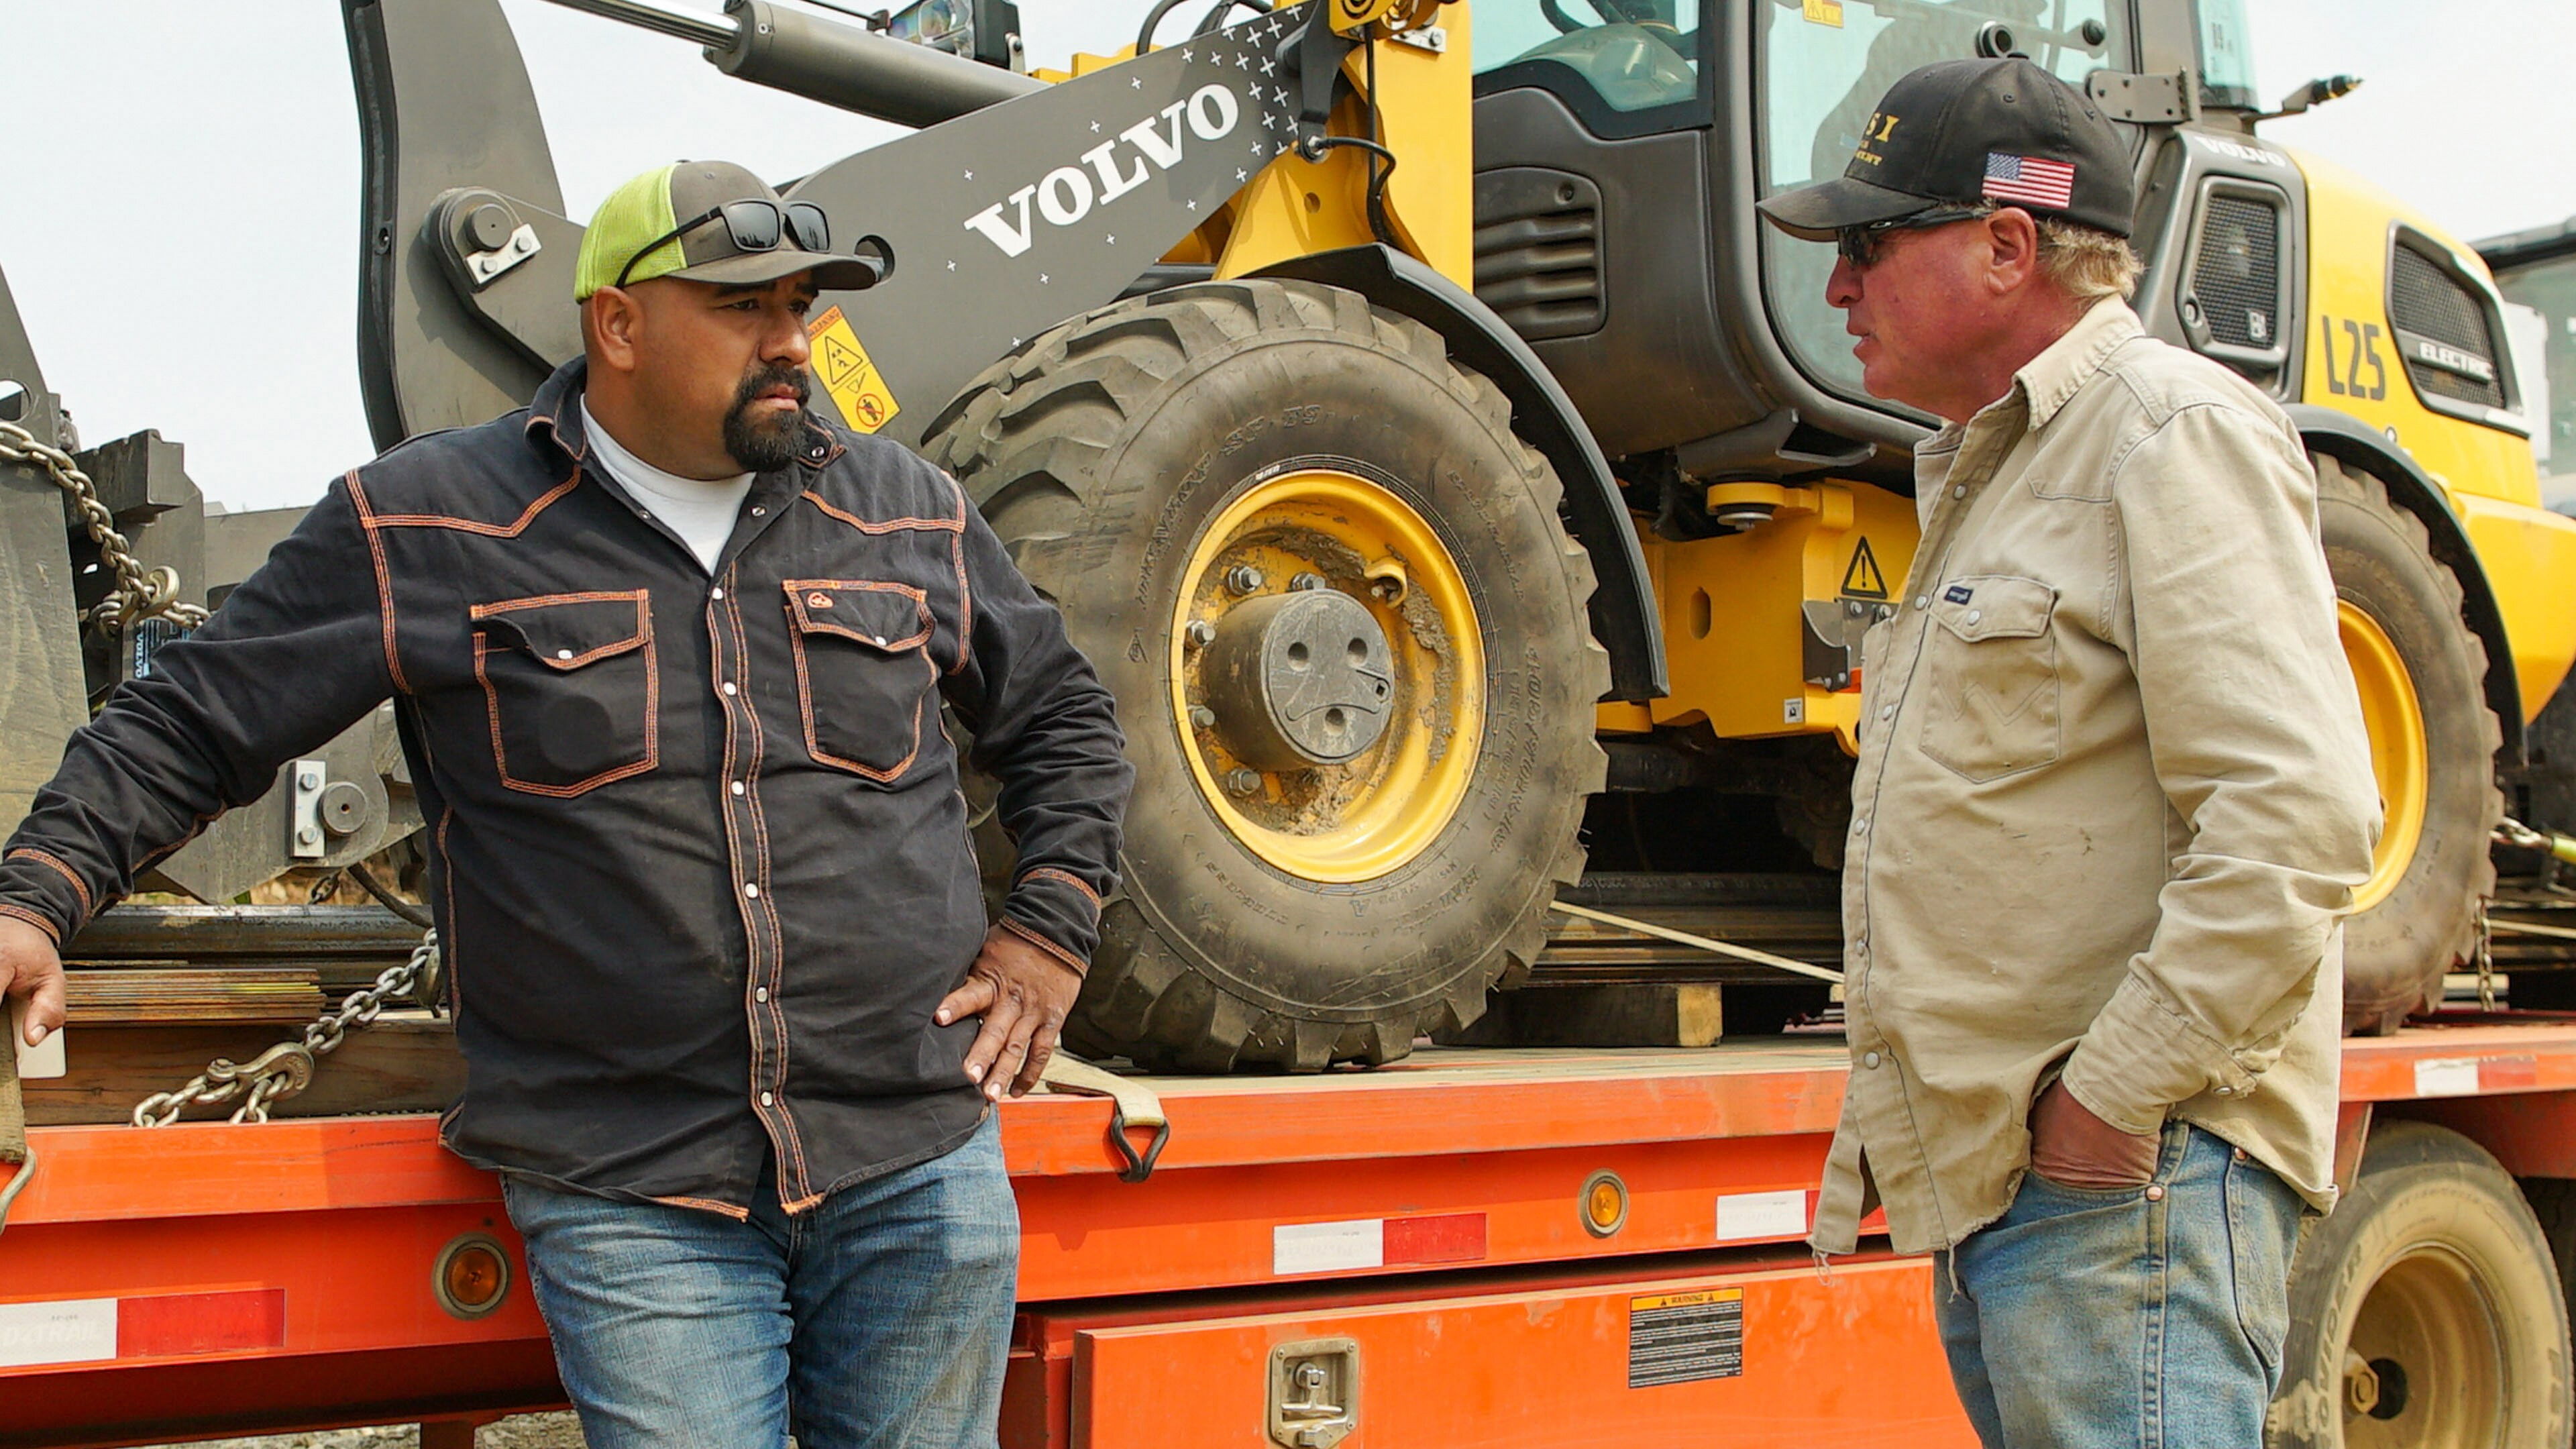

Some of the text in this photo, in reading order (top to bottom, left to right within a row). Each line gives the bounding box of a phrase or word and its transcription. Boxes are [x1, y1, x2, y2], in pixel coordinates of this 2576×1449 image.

[964, 83, 1238, 258] VOLVO
[2194, 136, 2286, 168] VOLVO
[2322, 315, 2385, 401] L25
[2419, 341, 2493, 380] ELECTRIC
[136, 631, 144, 678] VOLVO
[1672, 1295, 1703, 1303] WARNING
